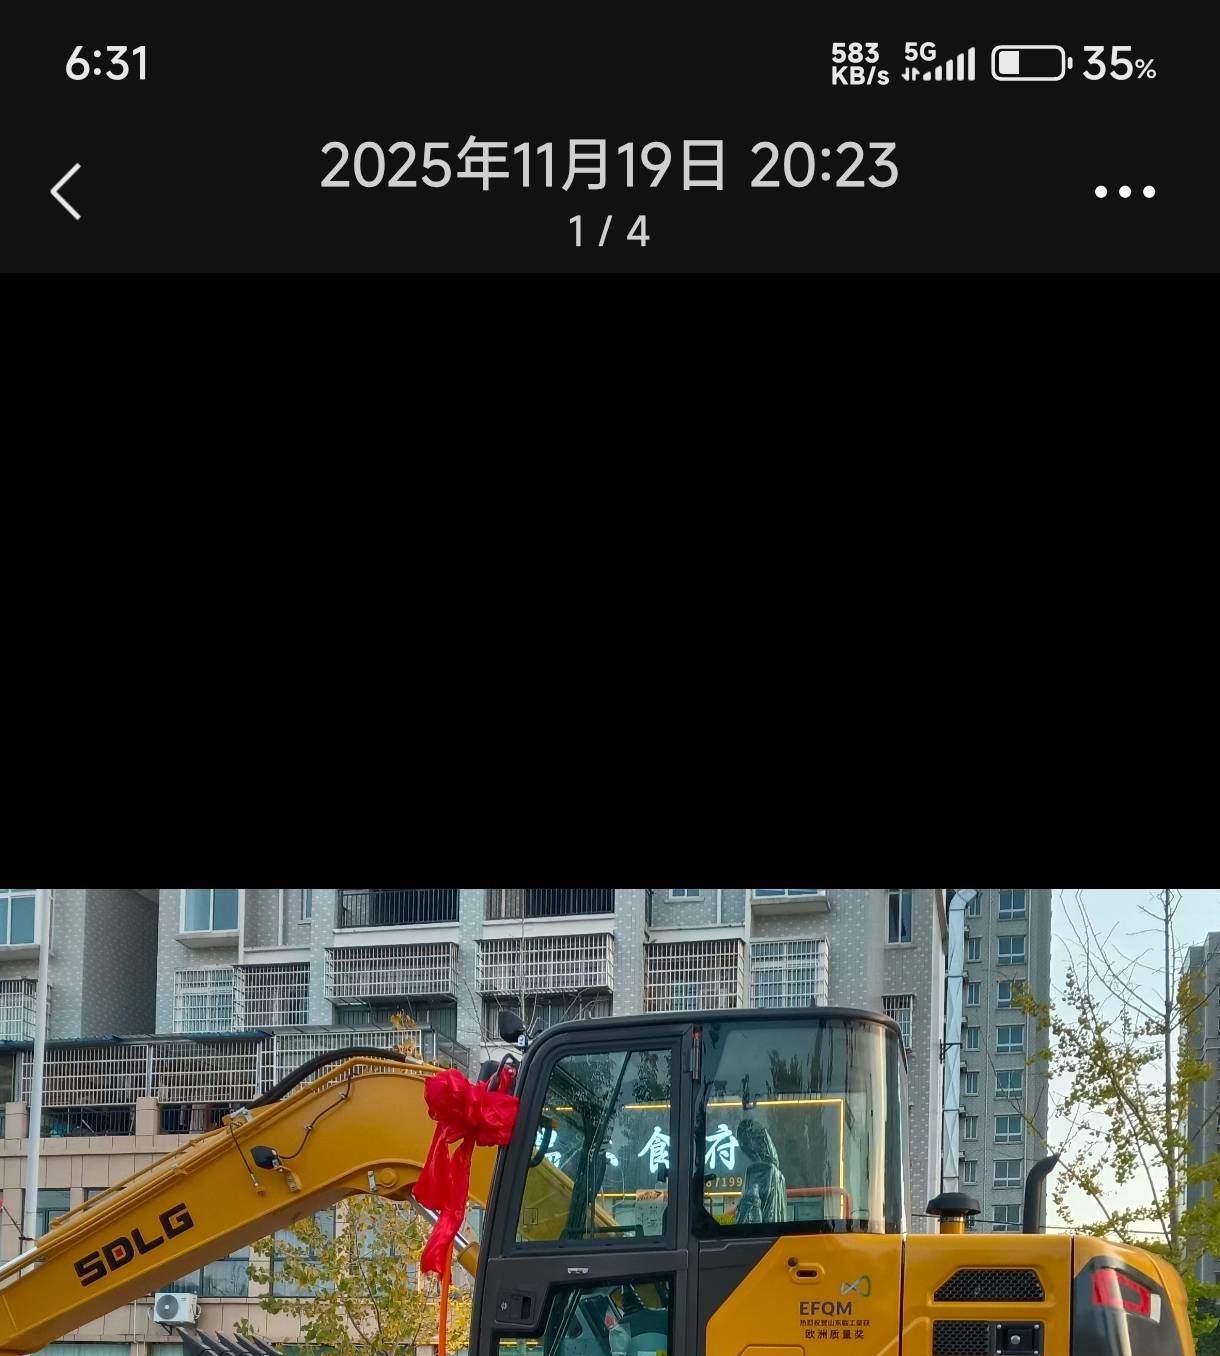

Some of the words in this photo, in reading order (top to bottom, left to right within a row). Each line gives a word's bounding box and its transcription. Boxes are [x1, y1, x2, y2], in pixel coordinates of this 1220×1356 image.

[73, 1202, 195, 1287] SDLG
[799, 1301, 853, 1317] EFQM
[805, 1328, 865, 1340] 欧洲质量奖
